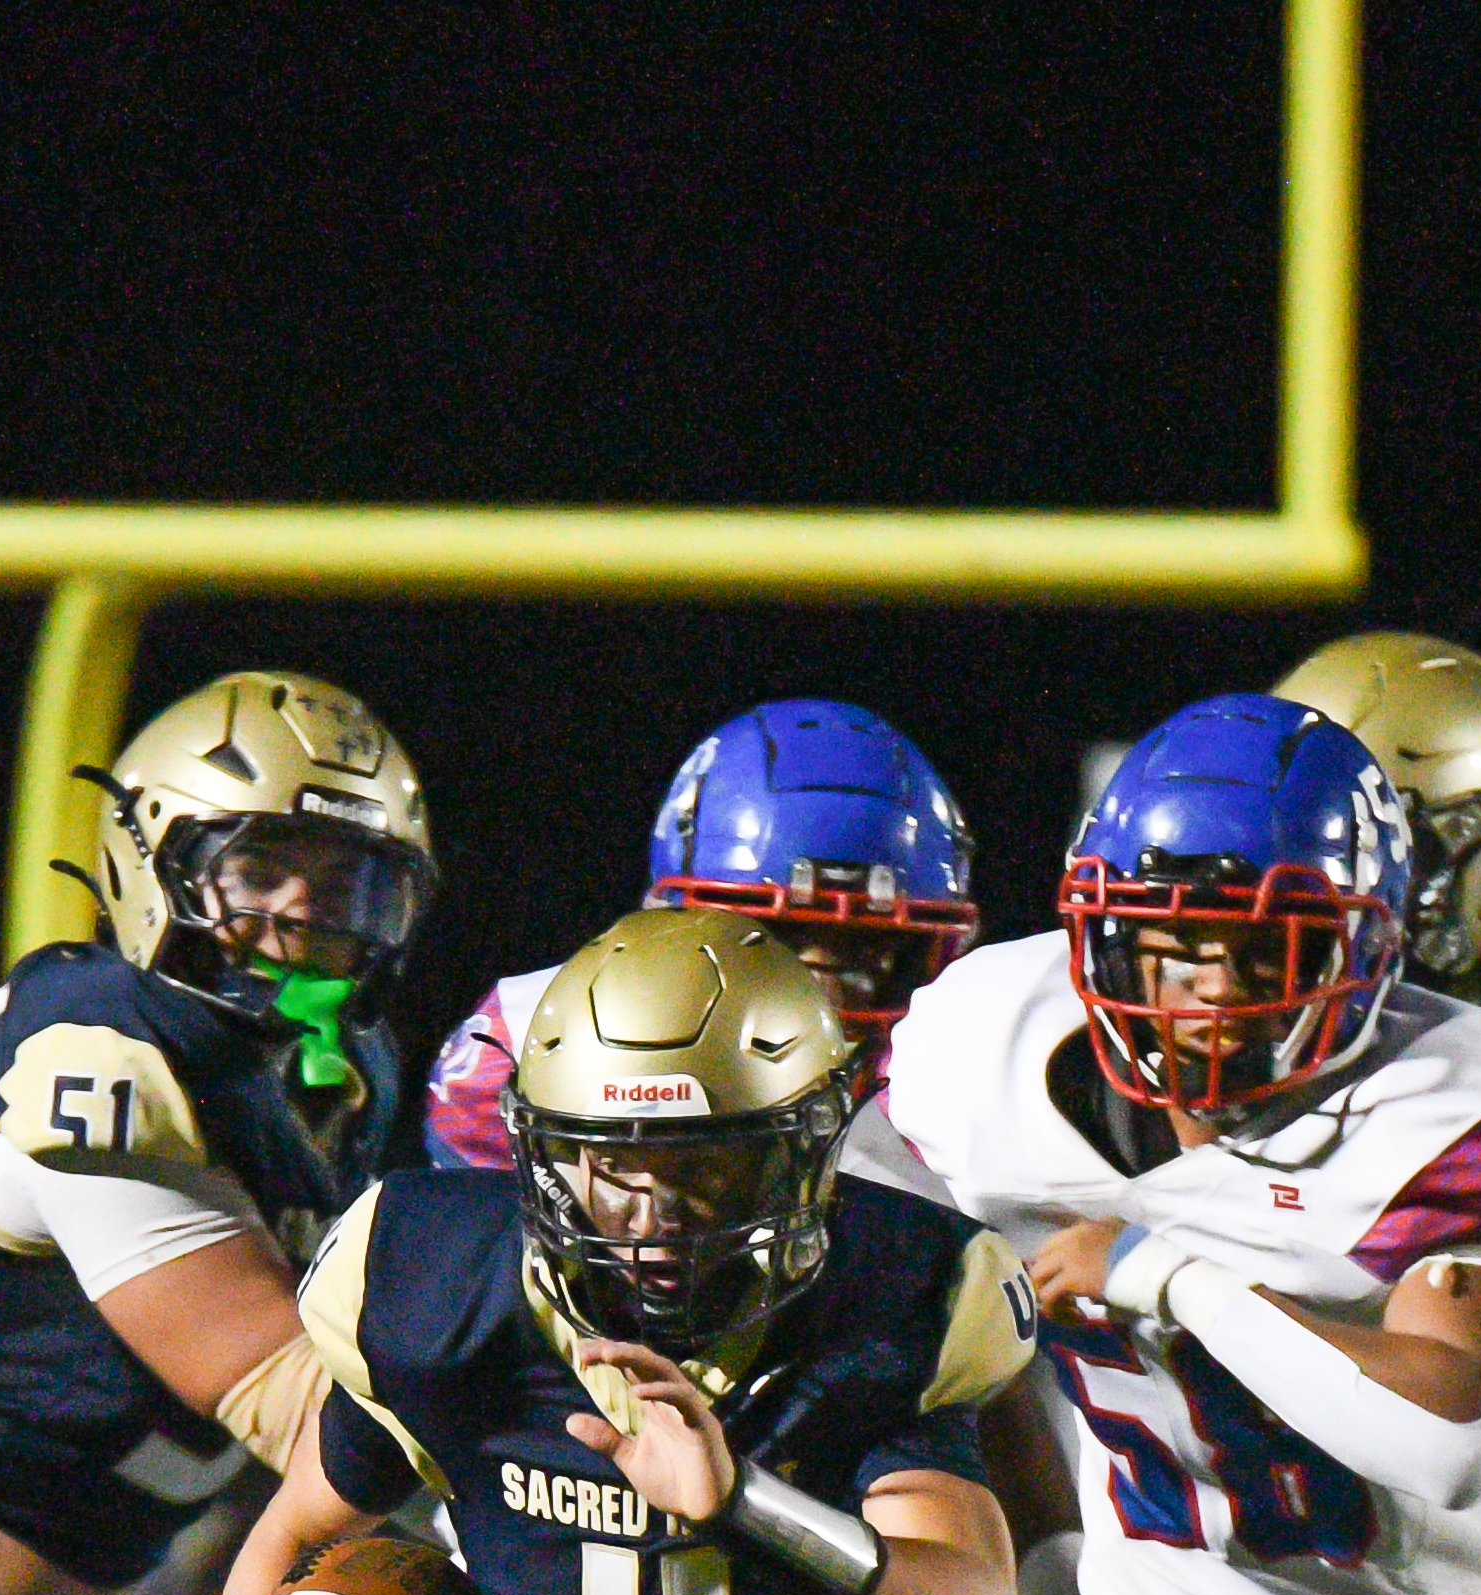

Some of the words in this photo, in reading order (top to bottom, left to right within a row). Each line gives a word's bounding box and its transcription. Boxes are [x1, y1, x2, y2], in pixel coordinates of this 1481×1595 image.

[48, 1073, 137, 1152] 51
[604, 1083, 691, 1102] Riddell
[500, 1461, 649, 1538] SACRED
